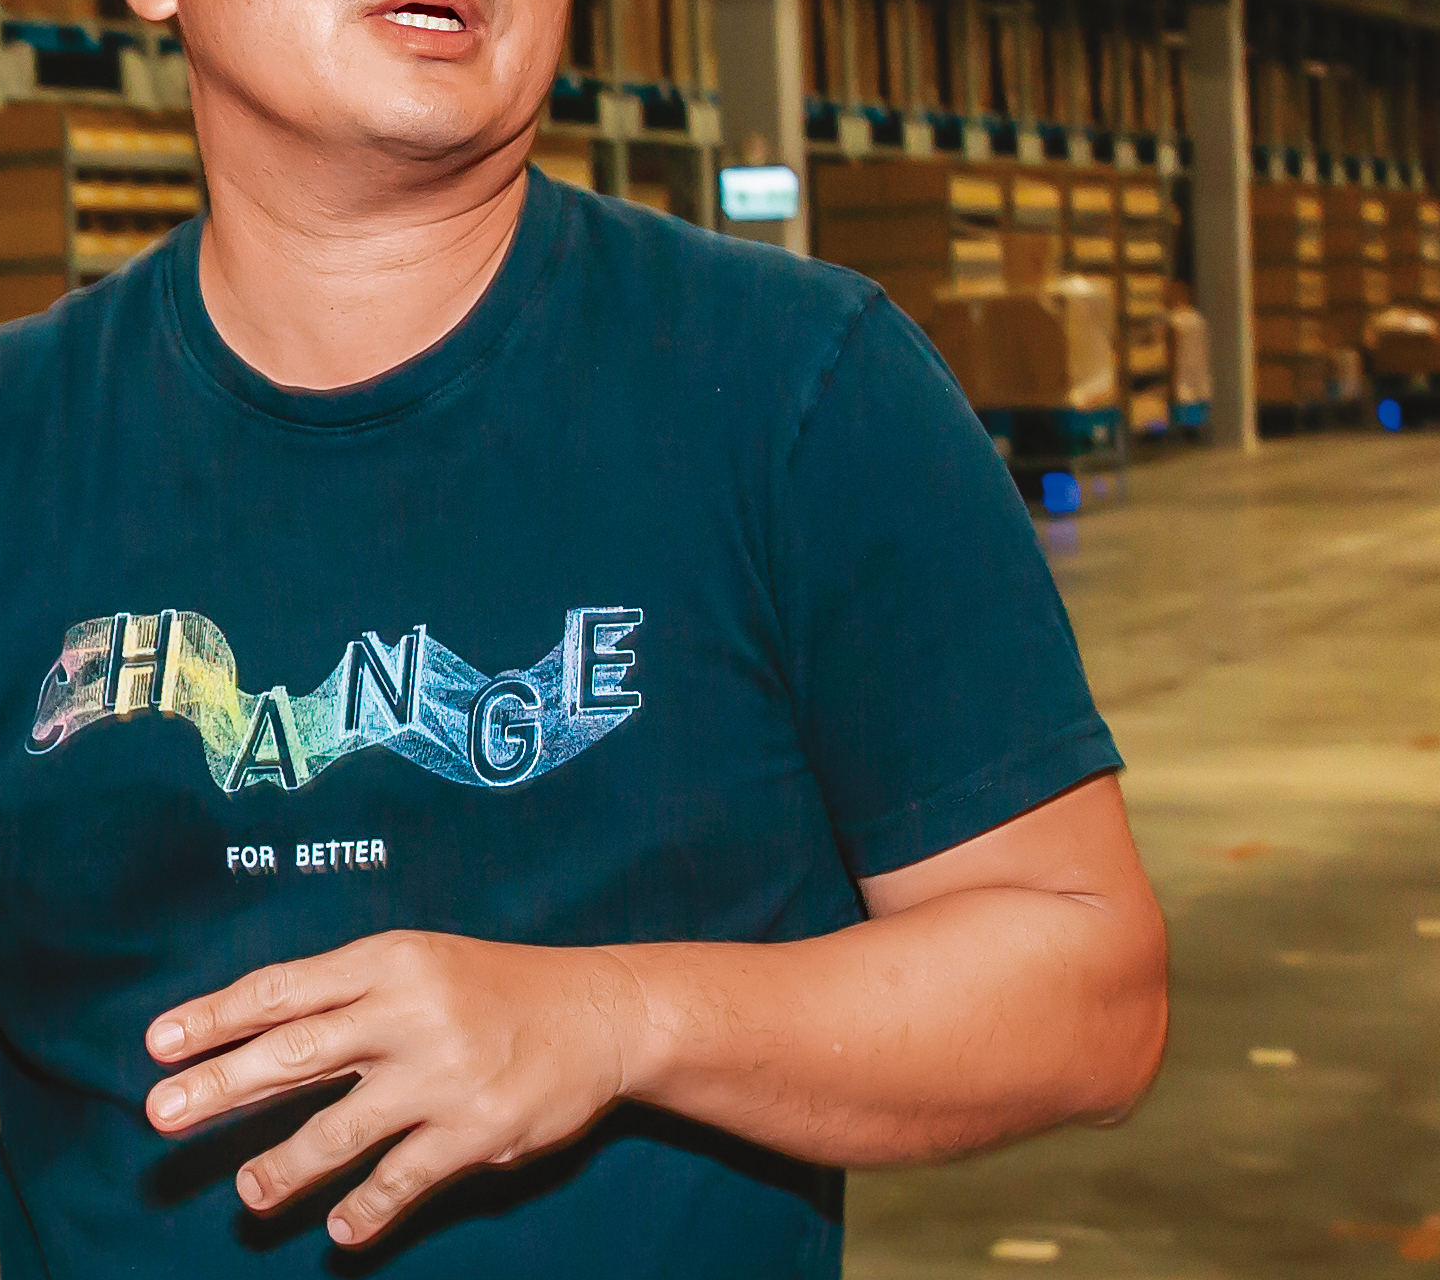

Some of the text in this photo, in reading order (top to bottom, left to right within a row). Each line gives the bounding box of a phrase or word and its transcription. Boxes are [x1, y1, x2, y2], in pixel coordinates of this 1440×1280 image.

[24, 607, 644, 793] CHANGE
[226, 838, 386, 870] FOR BETTER
